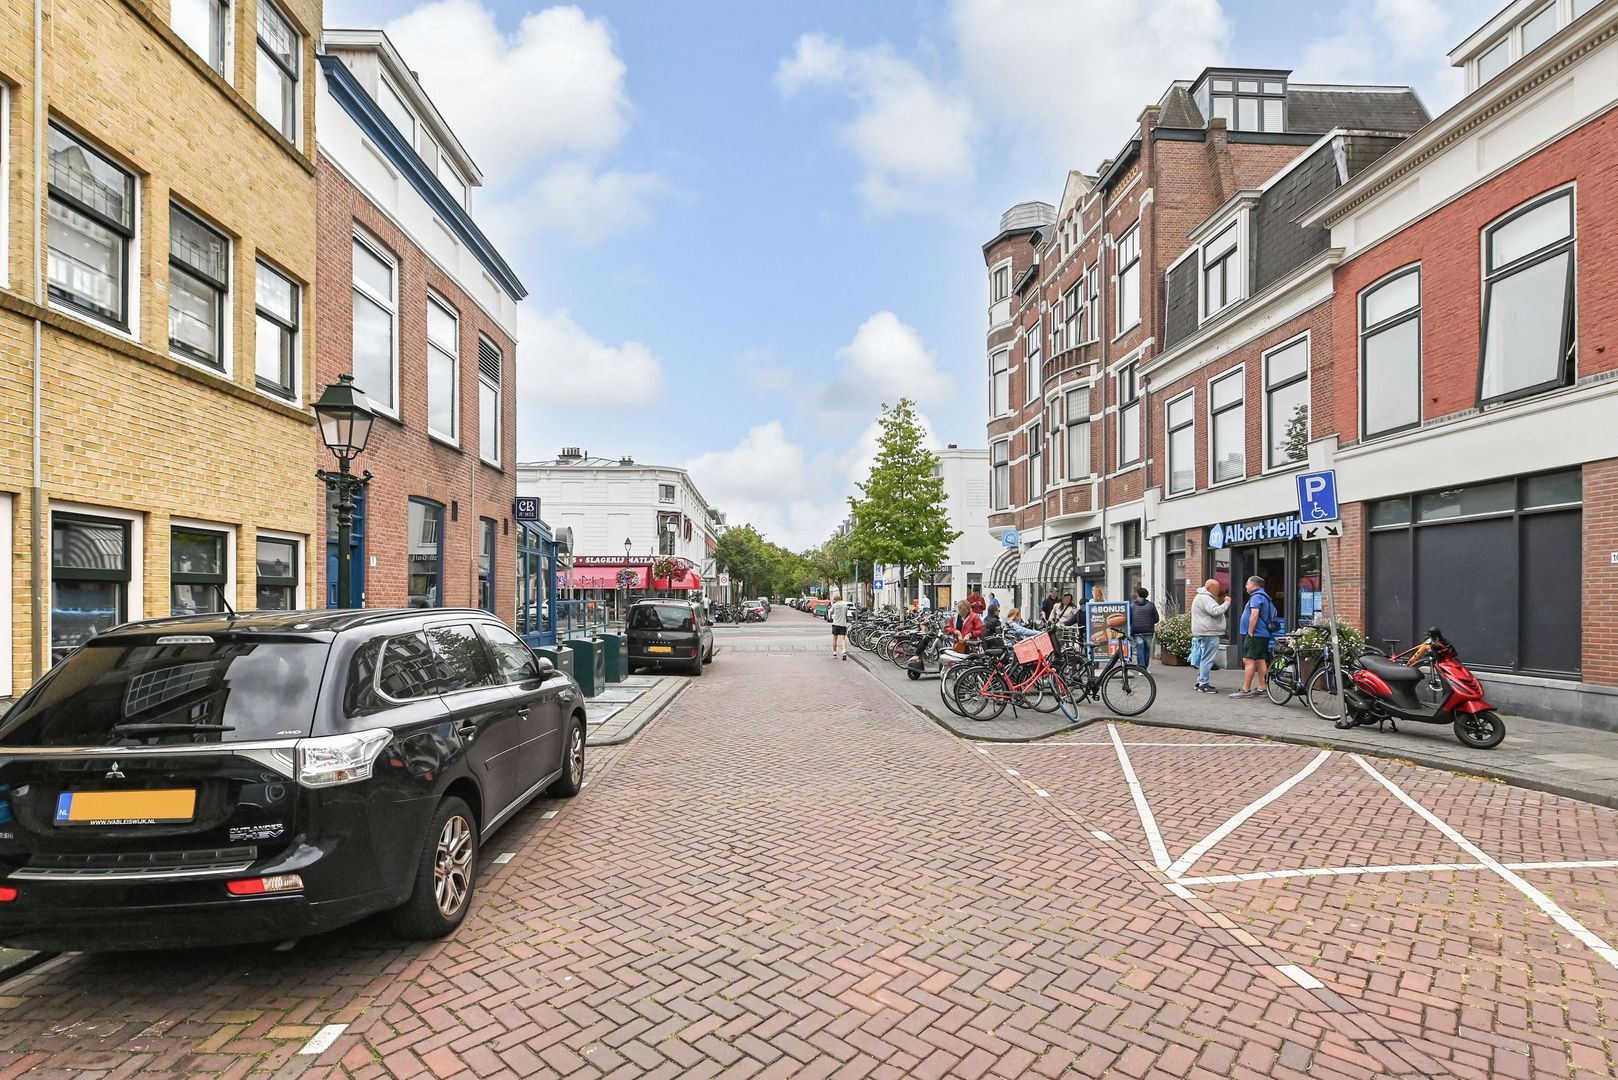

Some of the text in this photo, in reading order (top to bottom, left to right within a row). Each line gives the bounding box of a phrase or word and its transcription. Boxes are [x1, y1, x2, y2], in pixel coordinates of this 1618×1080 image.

[1305, 476, 1327, 502] P
[518, 500, 535, 512] CB
[1225, 522, 1265, 544] Albert
[1267, 516, 1303, 540] Heijn
[584, 556, 624, 564] SLAGERIJ
[1097, 605, 1126, 613] BONUS
[229, 823, 283, 834] OUTLANDER
